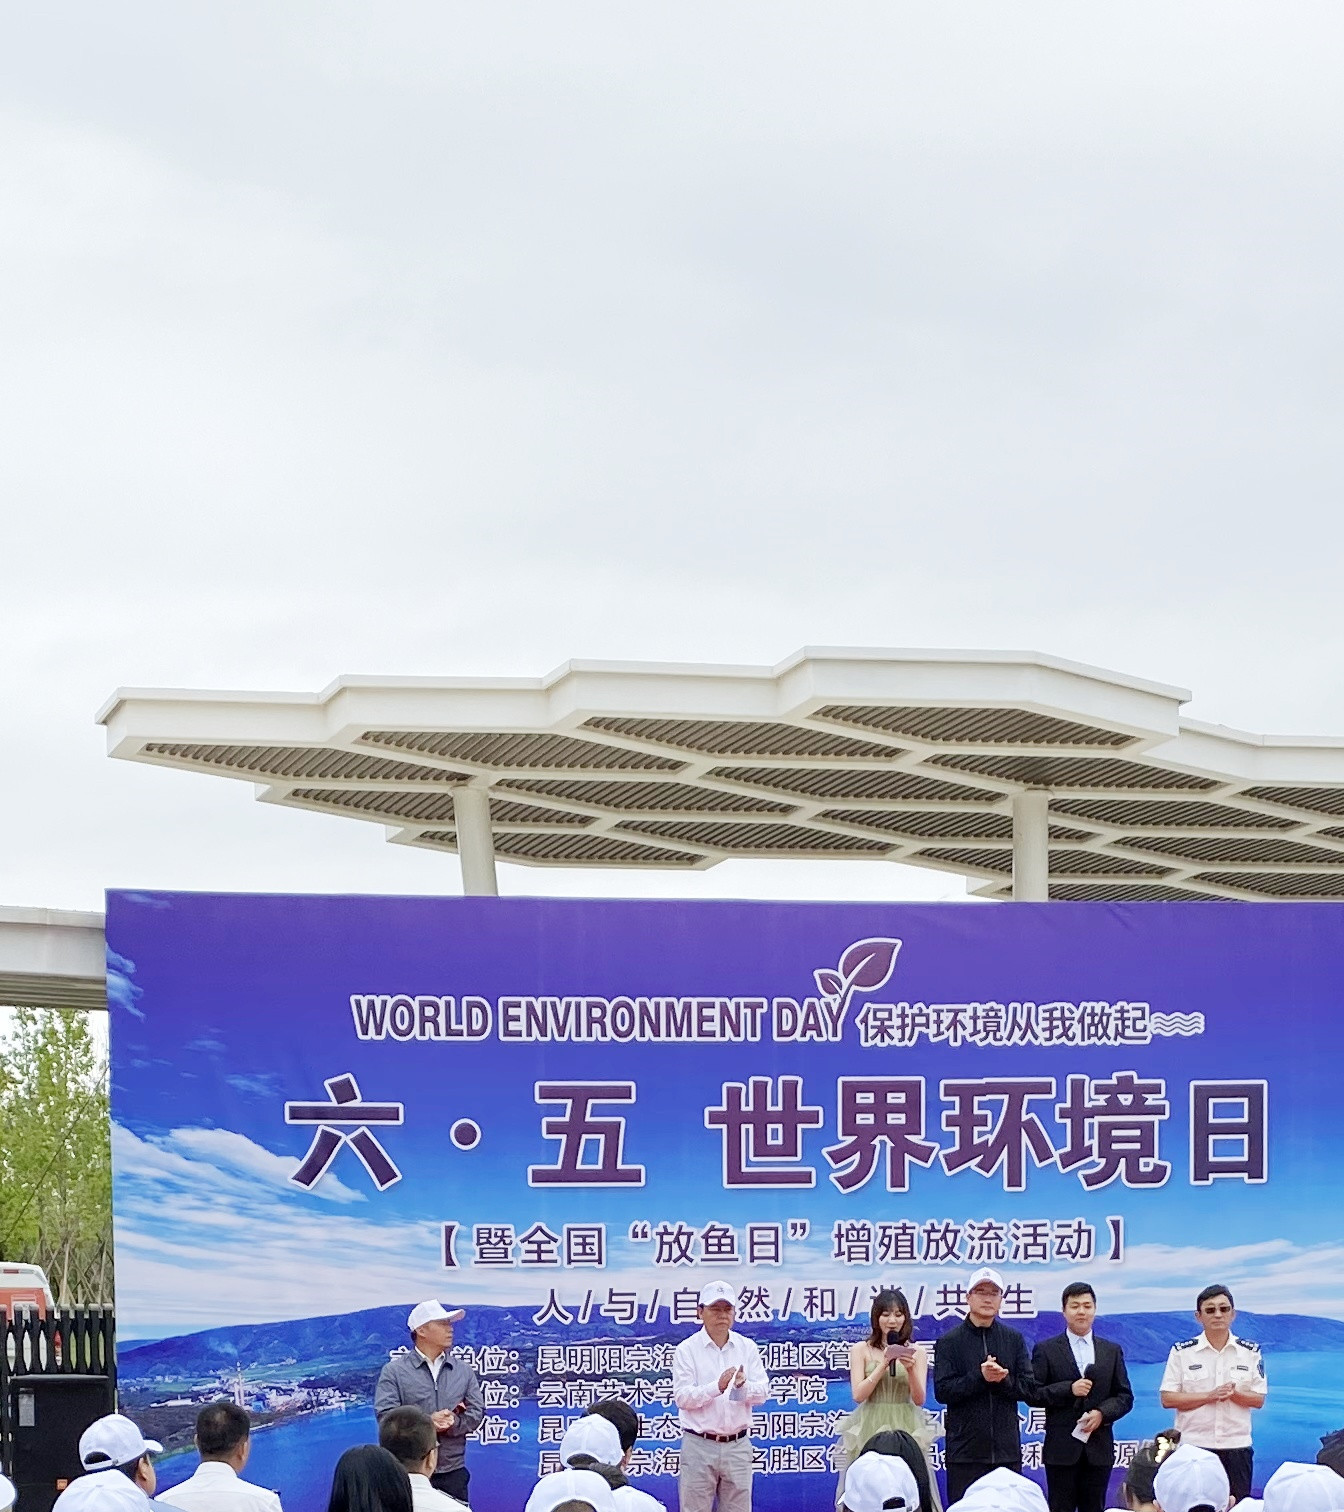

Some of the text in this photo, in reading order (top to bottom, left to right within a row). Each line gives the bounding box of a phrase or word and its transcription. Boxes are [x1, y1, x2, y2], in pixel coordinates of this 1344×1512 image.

[353, 996, 848, 1041] WORLD ENVIRONMENT DAY
[857, 1002, 1153, 1045] 保护环境从我做起
[703, 1073, 1269, 1193] 世界环境日
